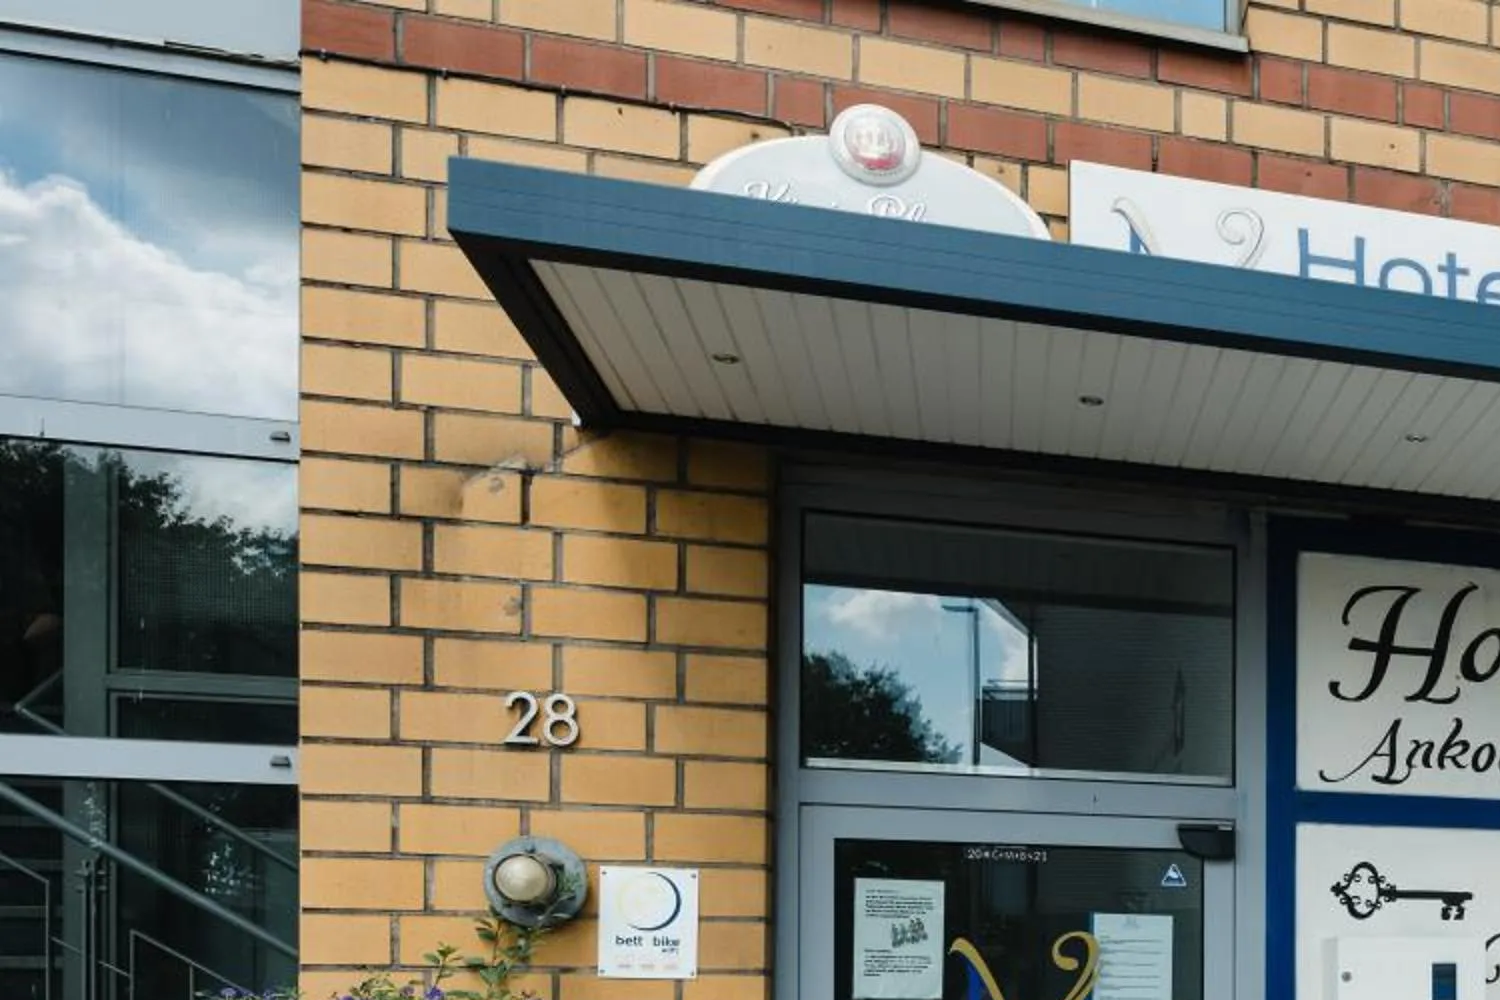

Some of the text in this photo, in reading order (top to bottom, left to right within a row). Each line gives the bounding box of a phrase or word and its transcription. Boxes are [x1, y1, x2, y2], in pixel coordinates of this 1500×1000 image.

[504, 691, 579, 746] 28
[615, 935, 680, 947] bett bike
